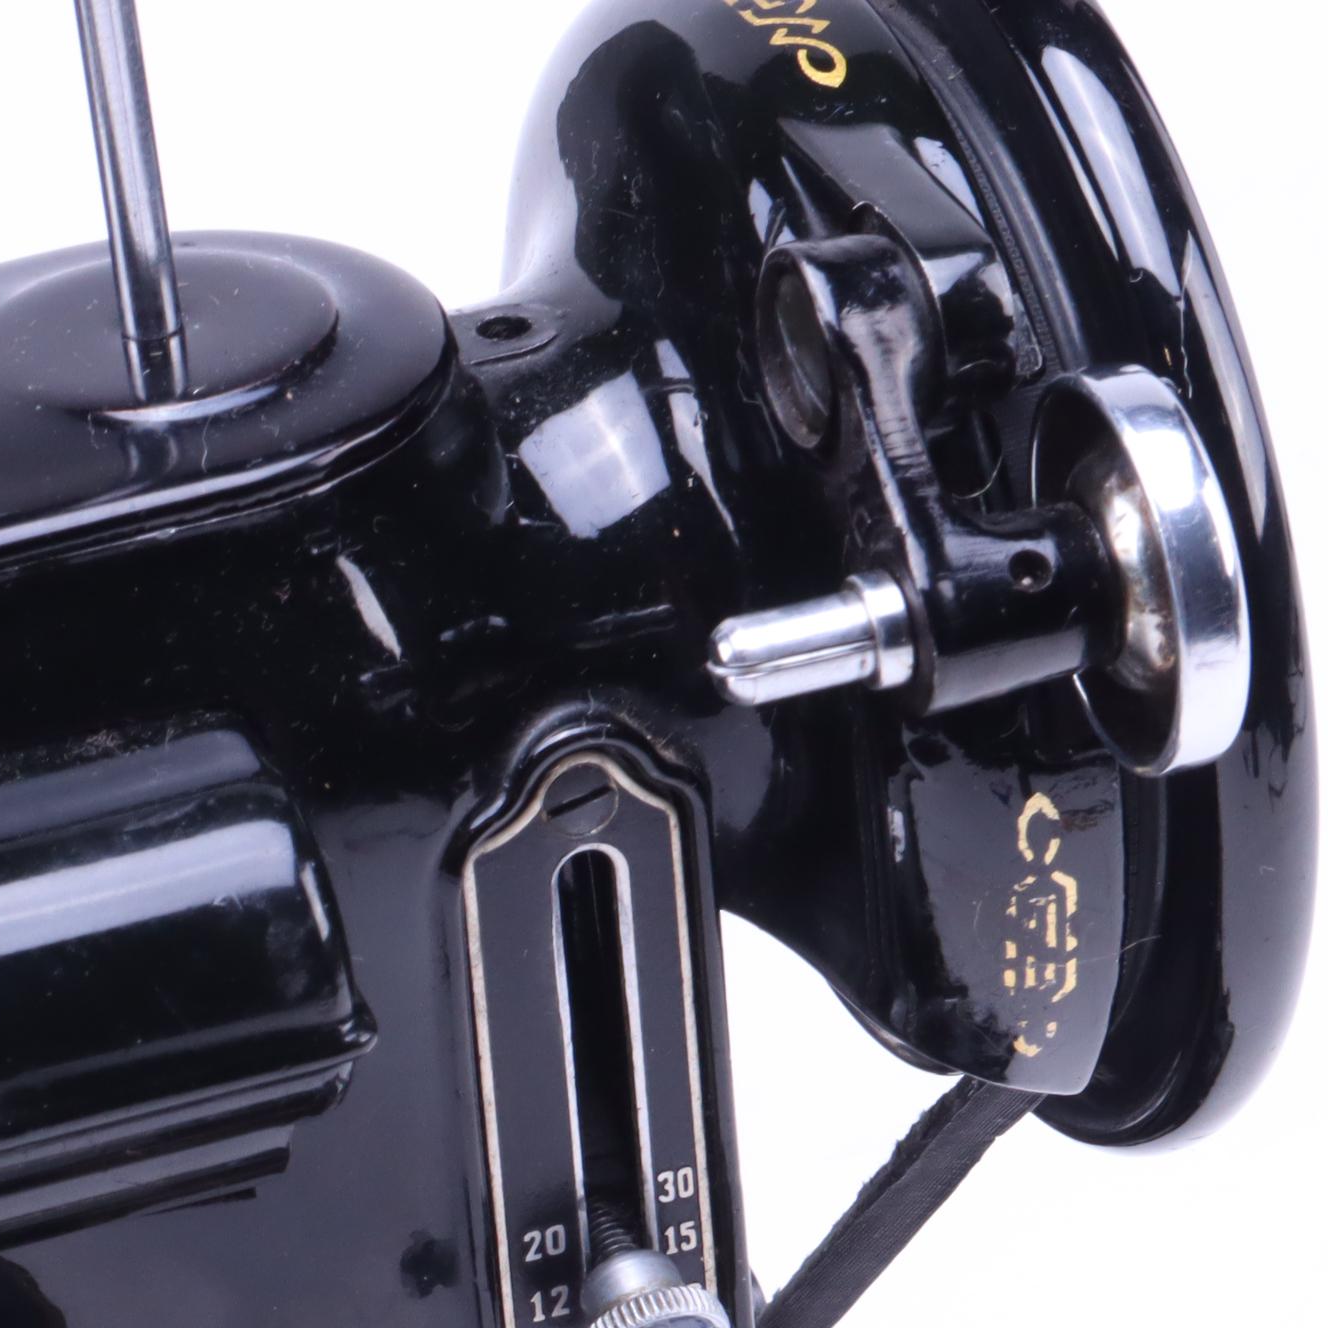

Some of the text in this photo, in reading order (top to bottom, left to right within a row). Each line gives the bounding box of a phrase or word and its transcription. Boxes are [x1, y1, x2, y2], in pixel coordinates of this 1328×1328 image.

[657, 1166, 695, 1203] 30
[523, 1224, 566, 1262] 20
[664, 1220, 698, 1255] 15
[530, 1285, 570, 1322] 12
